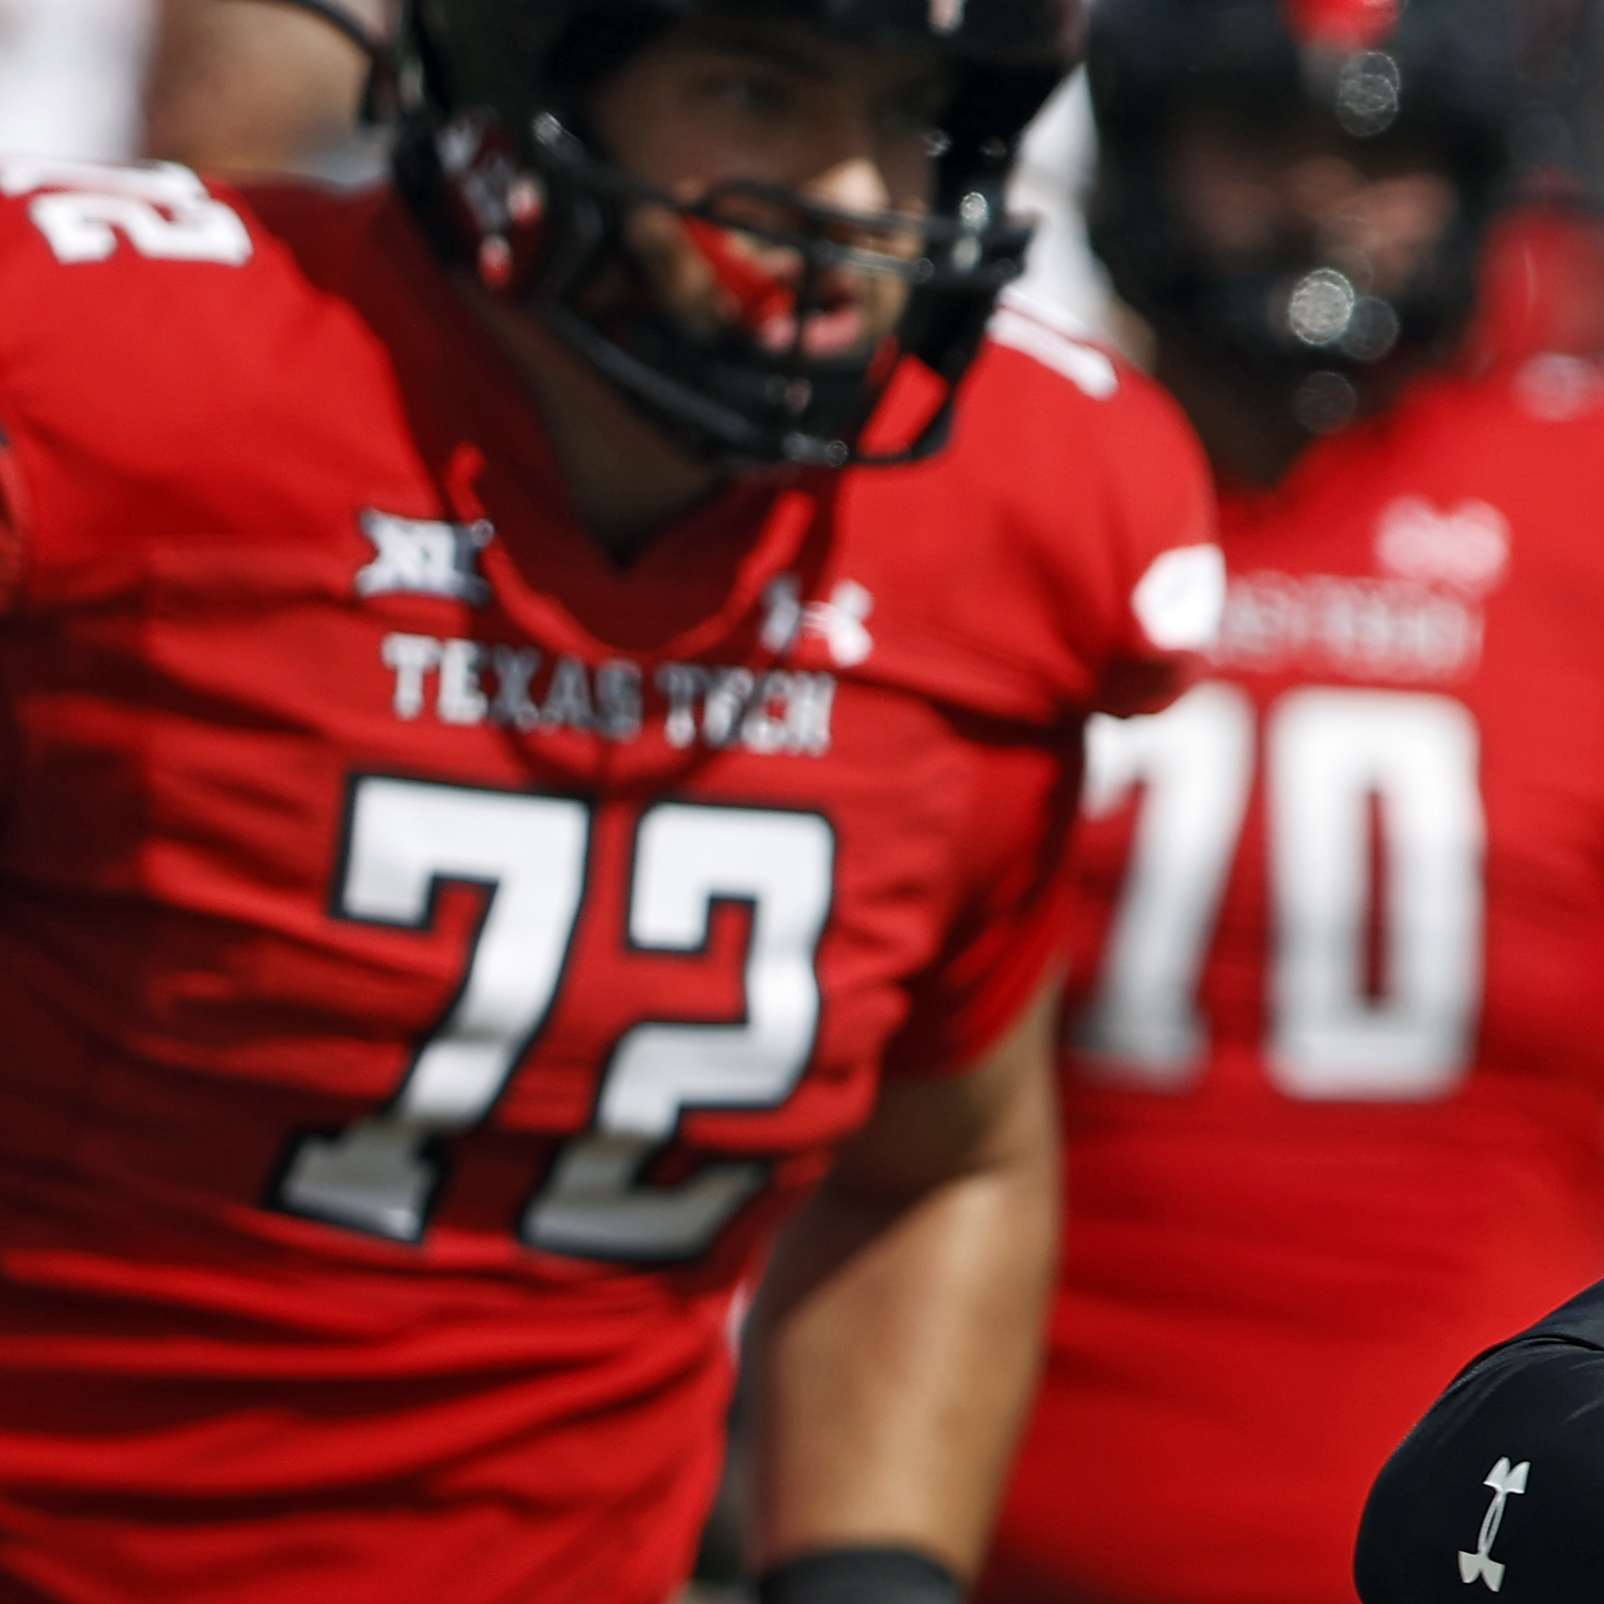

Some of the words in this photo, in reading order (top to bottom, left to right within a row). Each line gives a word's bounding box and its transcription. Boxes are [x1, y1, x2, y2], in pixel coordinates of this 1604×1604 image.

[381, 632, 644, 743] TEXAS
[1063, 680, 1488, 1102] 70
[268, 772, 838, 1259] 72
